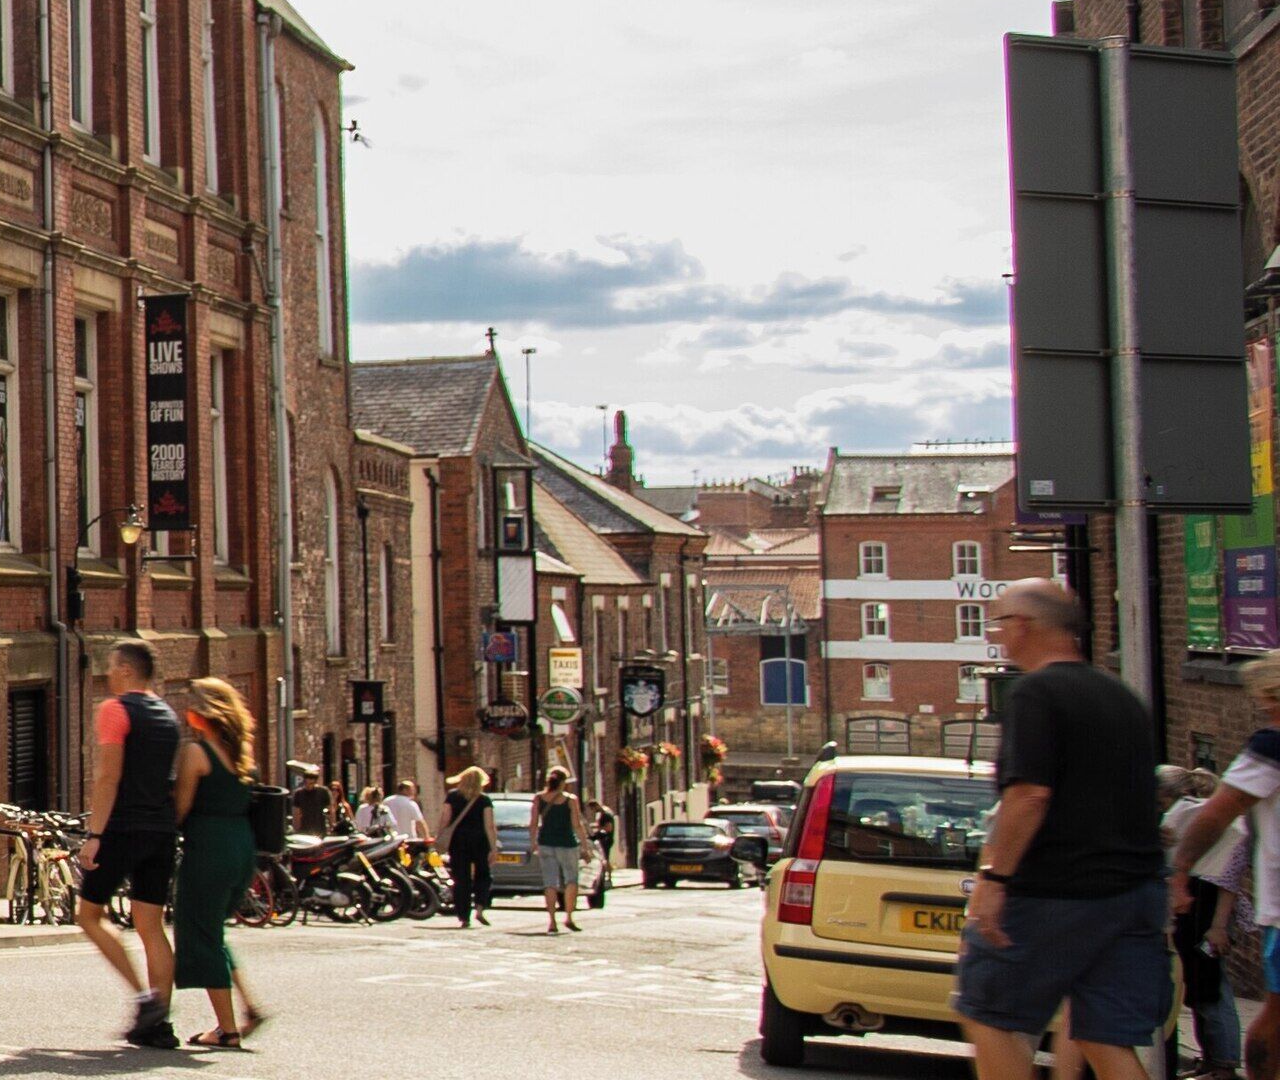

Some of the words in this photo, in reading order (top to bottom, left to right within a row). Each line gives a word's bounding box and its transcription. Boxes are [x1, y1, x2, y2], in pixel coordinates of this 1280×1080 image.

[150, 341, 182, 363] LIVE
[150, 361, 183, 375] SHOWS
[150, 409, 163, 422] OF
[164, 408, 183, 421] FUN
[151, 444, 184, 461] 2000
[553, 660, 578, 670] TAXIS
